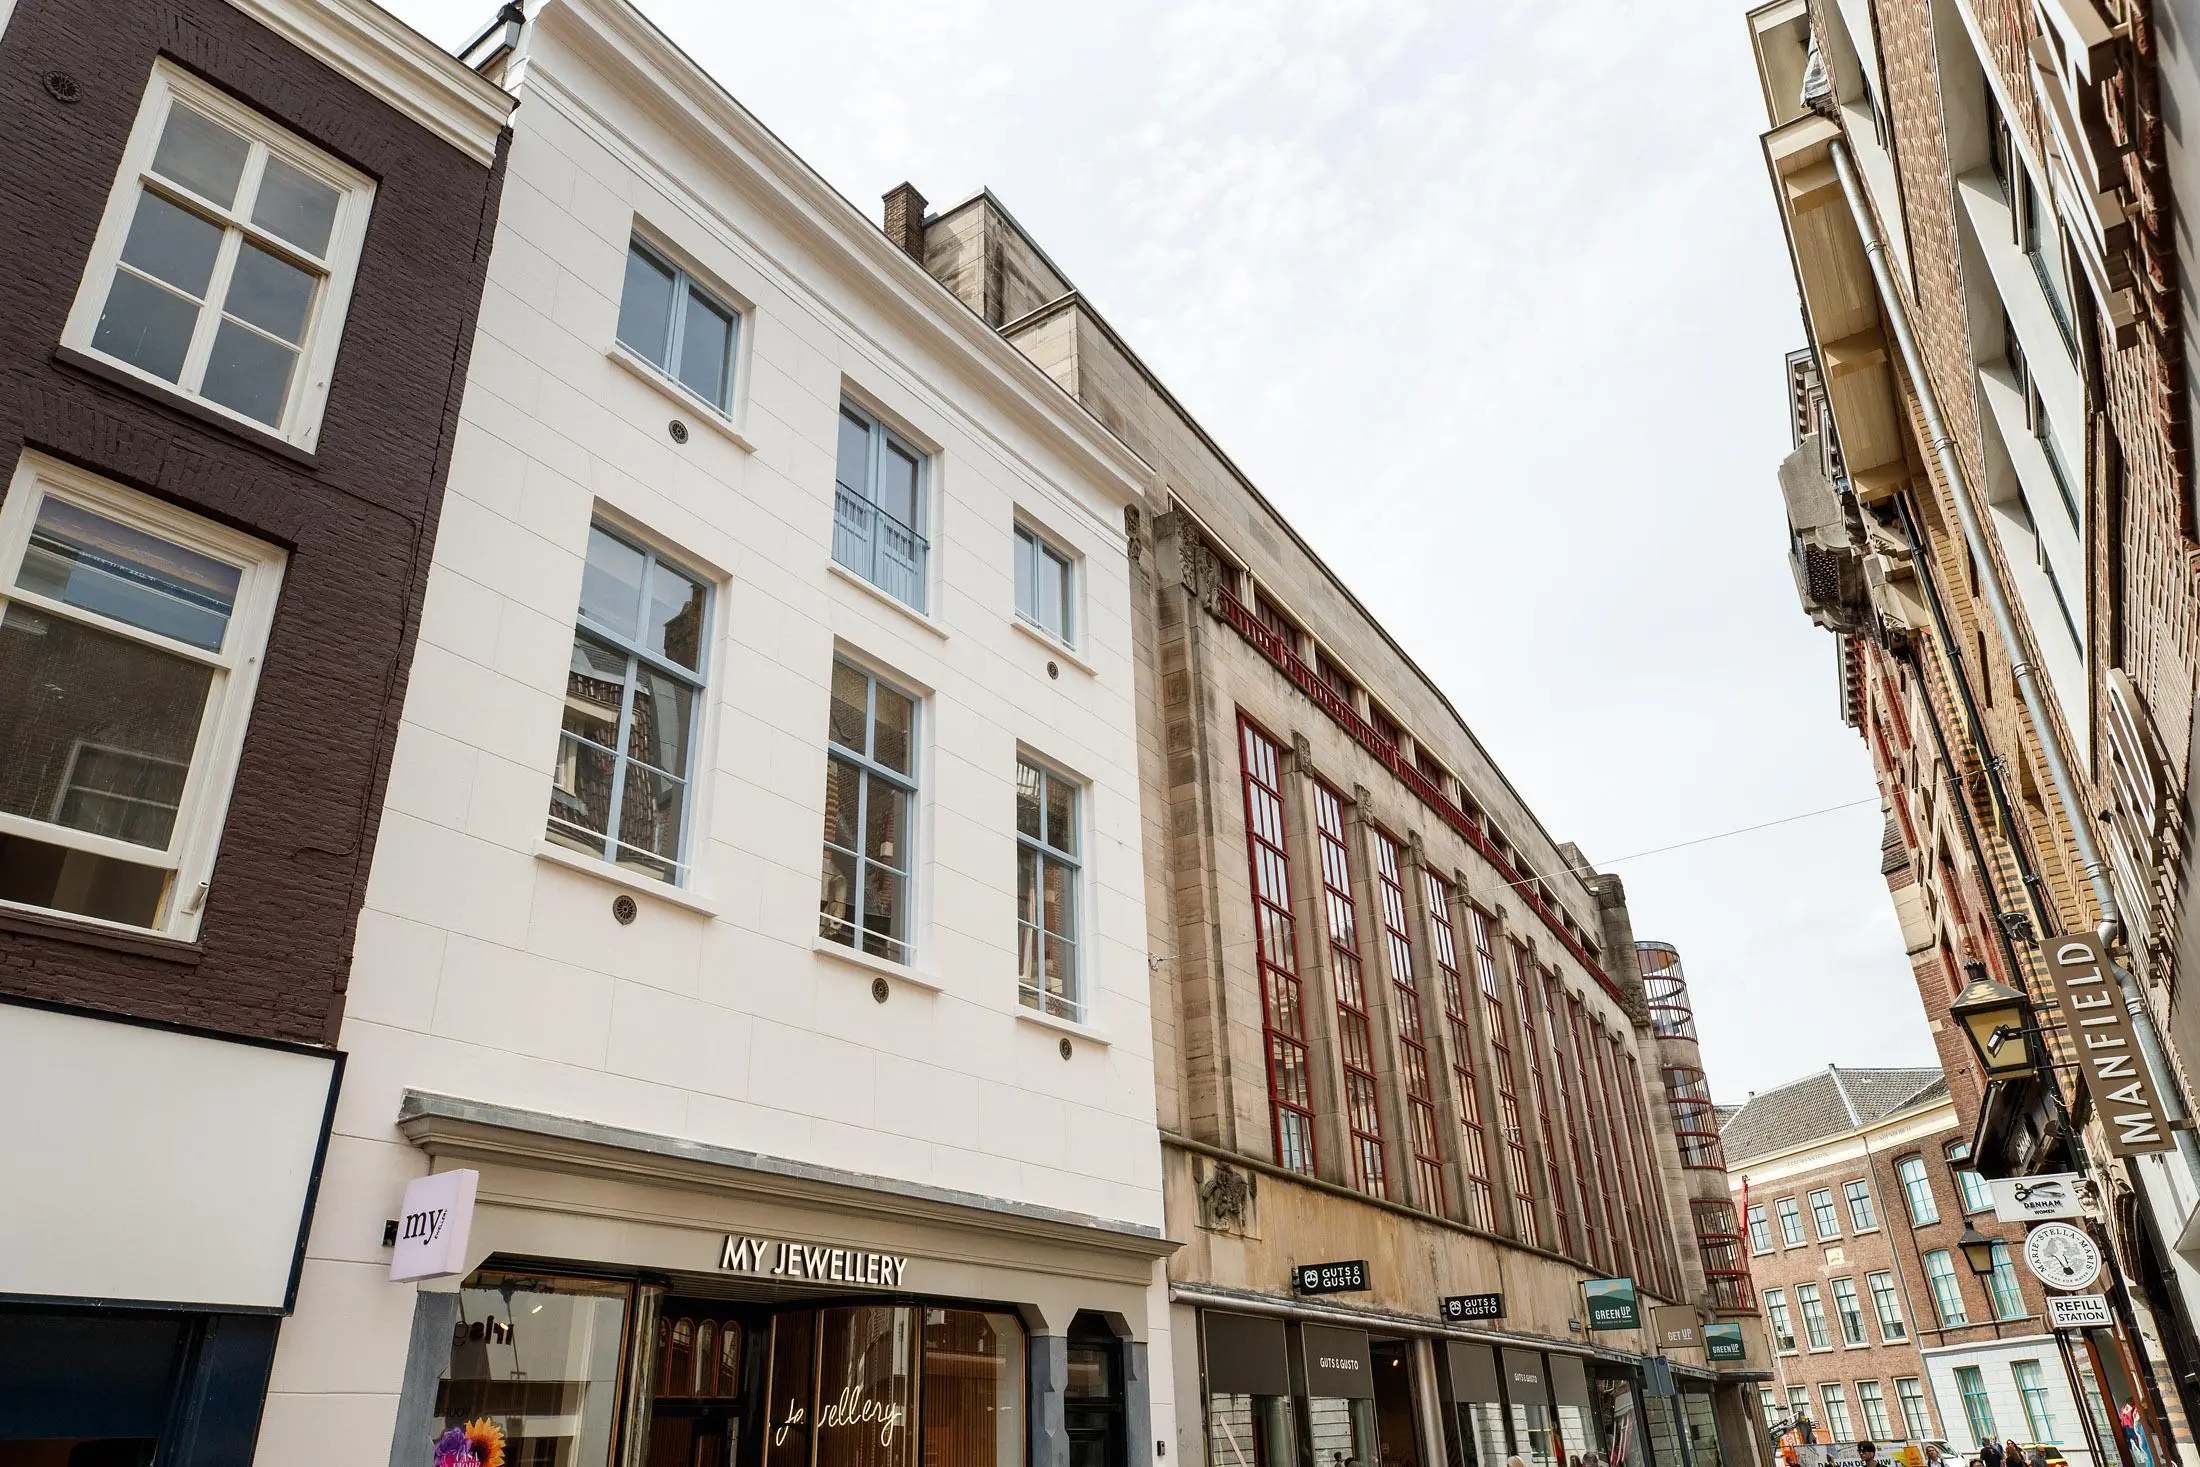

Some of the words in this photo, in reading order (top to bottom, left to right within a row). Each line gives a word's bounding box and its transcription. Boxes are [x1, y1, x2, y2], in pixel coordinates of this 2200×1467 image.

[2056, 942, 2161, 1144] MANFIELD
[2023, 1199, 2062, 1209] DENHAM
[403, 1208, 444, 1246] my
[720, 1234, 768, 1272] MY
[772, 1242, 908, 1286] JEWELLERY
[1322, 1266, 1351, 1278] GUTS
[1353, 1265, 1360, 1275] &
[1322, 1275, 1361, 1287] GUSTO
[1464, 1298, 1488, 1307] GUTS
[1490, 1297, 1497, 1306] &
[2055, 1300, 2102, 1312] REFILL
[1465, 1305, 1497, 1315] GUSTO
[2058, 1311, 2105, 1322] STATION
[1667, 1331, 1681, 1341] GET
[1681, 1328, 1692, 1338] UP
[1319, 1356, 1335, 1369] GUTS
[1340, 1358, 1359, 1370] GUSTO
